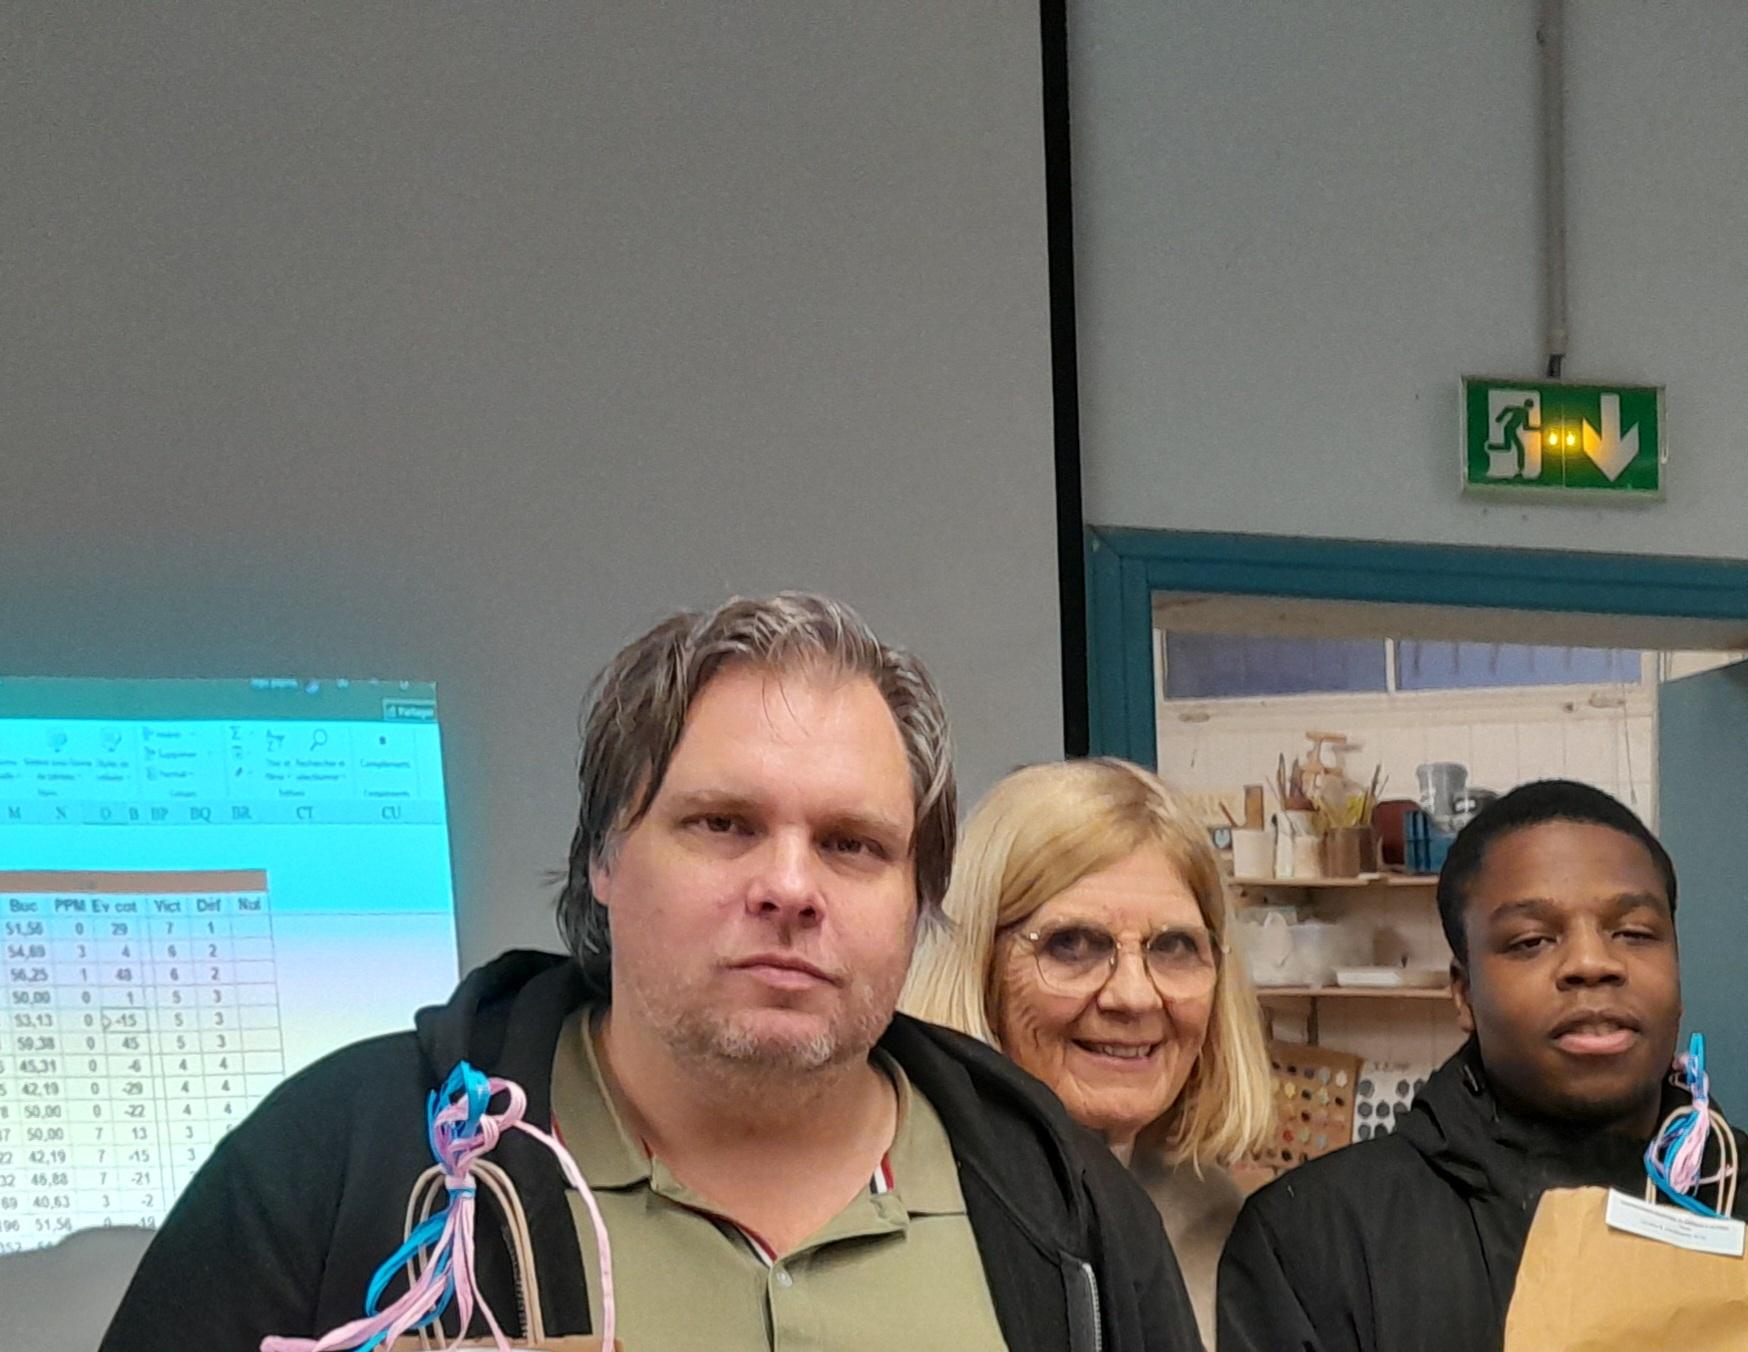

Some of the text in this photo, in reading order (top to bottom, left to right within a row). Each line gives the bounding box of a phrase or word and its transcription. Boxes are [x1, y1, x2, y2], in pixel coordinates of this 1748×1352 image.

[9, 806, 21, 819] M
[296, 806, 314, 820] CT
[381, 806, 402, 820] CU
[75, 921, 84, 935] 0
[77, 945, 86, 958] 3
[121, 945, 130, 958] 4
[208, 944, 217, 958] 2
[170, 967, 179, 981] 6
[211, 967, 220, 980] 2
[81, 990, 91, 1004] 0
[172, 990, 181, 1004] 5
[214, 989, 222, 1003] 3
[14, 1013, 53, 1028] 53,13
[84, 1013, 94, 1027] 0
[174, 1013, 183, 1026] 5
[215, 1012, 224, 1026] 3
[86, 1036, 95, 1050] 0
[176, 1035, 185, 1049] 5
[217, 1034, 226, 1048] 3
[88, 1058, 98, 1072] 0
[179, 1058, 188, 1071] 4
[219, 1056, 228, 1070] 4
[90, 1081, 100, 1096] 0
[181, 1080, 190, 1094] 4
[222, 1079, 231, 1092] 4
[24, 1104, 62, 1119] 50,00
[92, 1104, 102, 1118] 0
[124, 1104, 145, 1118] -22
[182, 1103, 191, 1116] 4
[223, 1103, 232, 1115] 4
[27, 1127, 64, 1142] 50,00
[95, 1126, 104, 1140] 7
[131, 1126, 148, 1140] 13
[186, 1125, 194, 1139] 3
[28, 1149, 67, 1165] 42,19
[98, 1149, 106, 1163] 7
[128, 1149, 150, 1163] -15
[188, 1148, 196, 1162] 3
[100, 1171, 108, 1185] 7
[131, 1171, 151, 1185] -21
[102, 1193, 110, 1207] 3
[141, 1193, 154, 1207] -2
